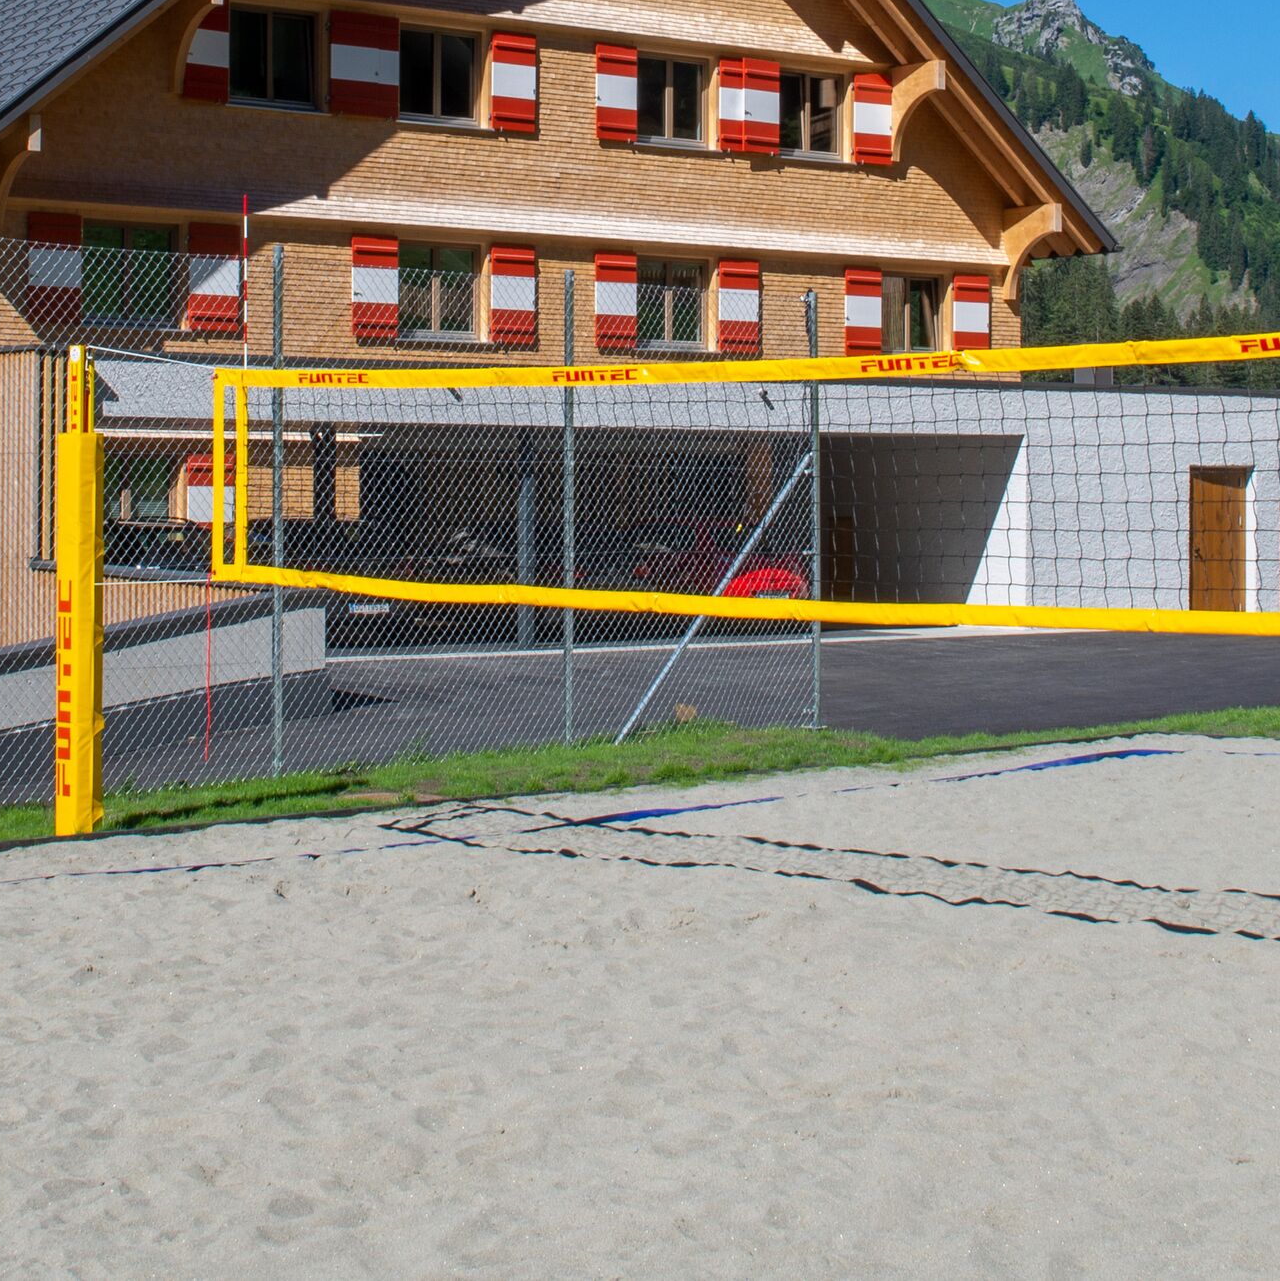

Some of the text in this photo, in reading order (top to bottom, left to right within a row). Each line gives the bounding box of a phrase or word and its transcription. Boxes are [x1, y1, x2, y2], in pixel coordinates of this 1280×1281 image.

[860, 354, 958, 373] FUNTEC
[298, 373, 368, 384] FUNTEC
[552, 368, 637, 382] FUNTEC
[57, 581, 71, 797] FUNTEC
